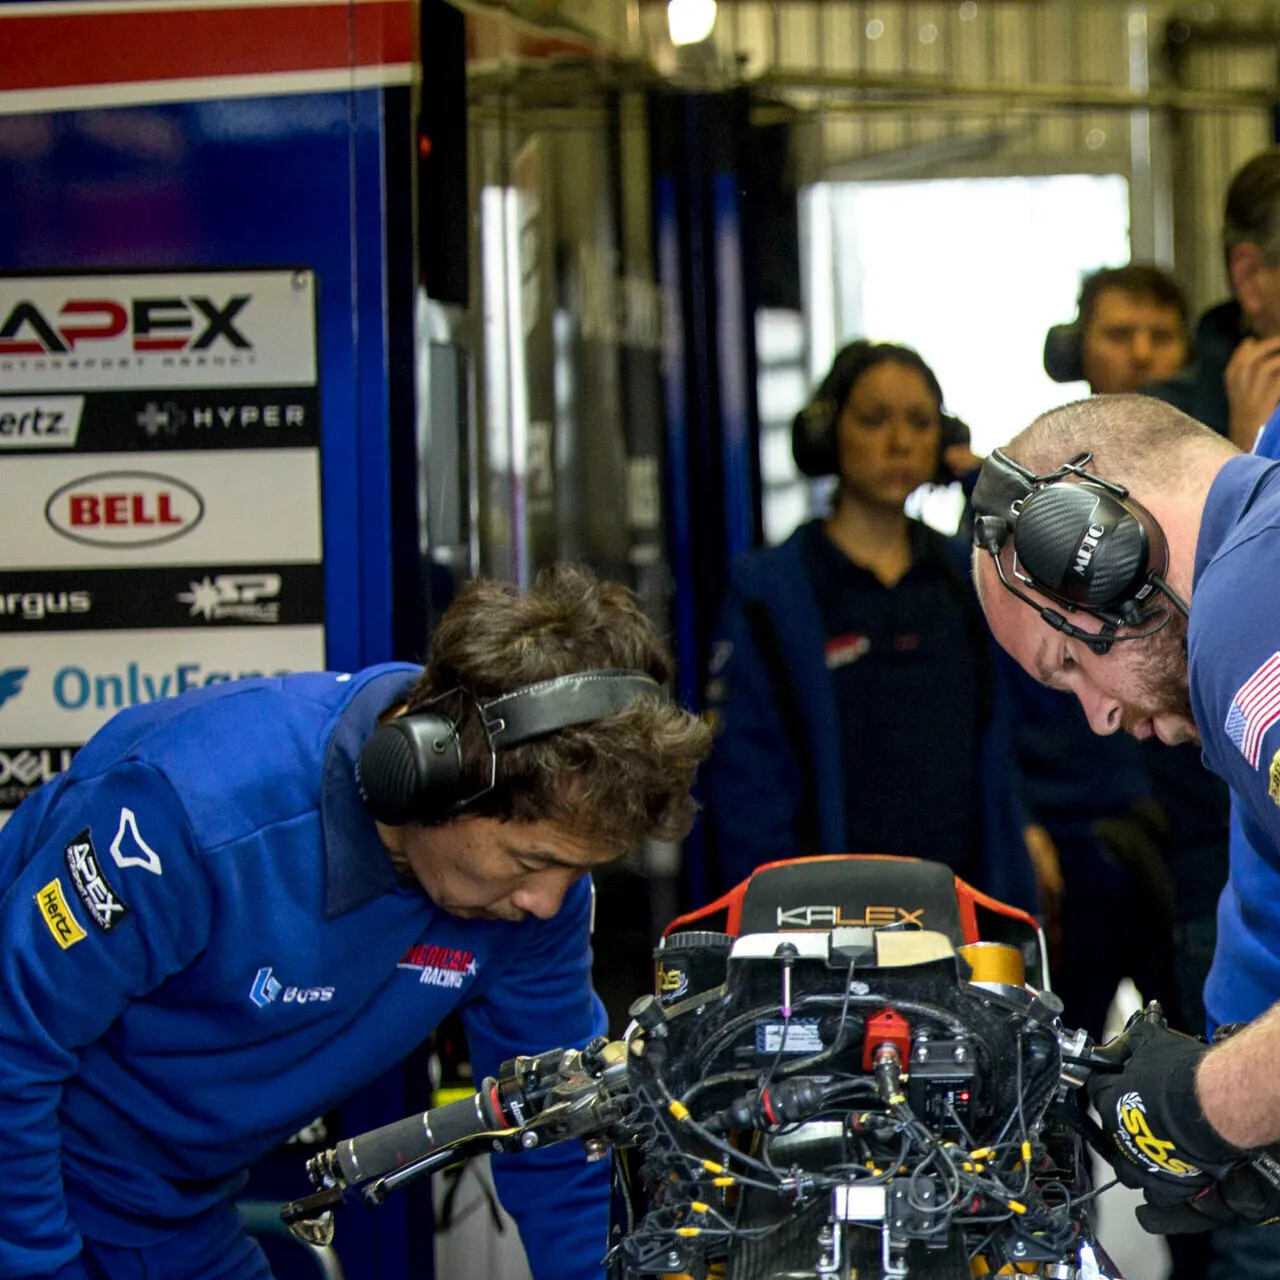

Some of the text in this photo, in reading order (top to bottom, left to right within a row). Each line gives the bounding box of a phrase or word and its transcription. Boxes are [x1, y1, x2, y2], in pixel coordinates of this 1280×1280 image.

[0, 294, 252, 353] APEX
[0, 407, 64, 435] ertz
[193, 404, 304, 428] HYPER
[68, 493, 183, 526] BELL
[53, 661, 292, 711] OnlyF
[73, 843, 124, 921] APEX
[43, 889, 72, 941] Hertz
[777, 906, 925, 926] KALEX
[1121, 1105, 1199, 1175] sbs
